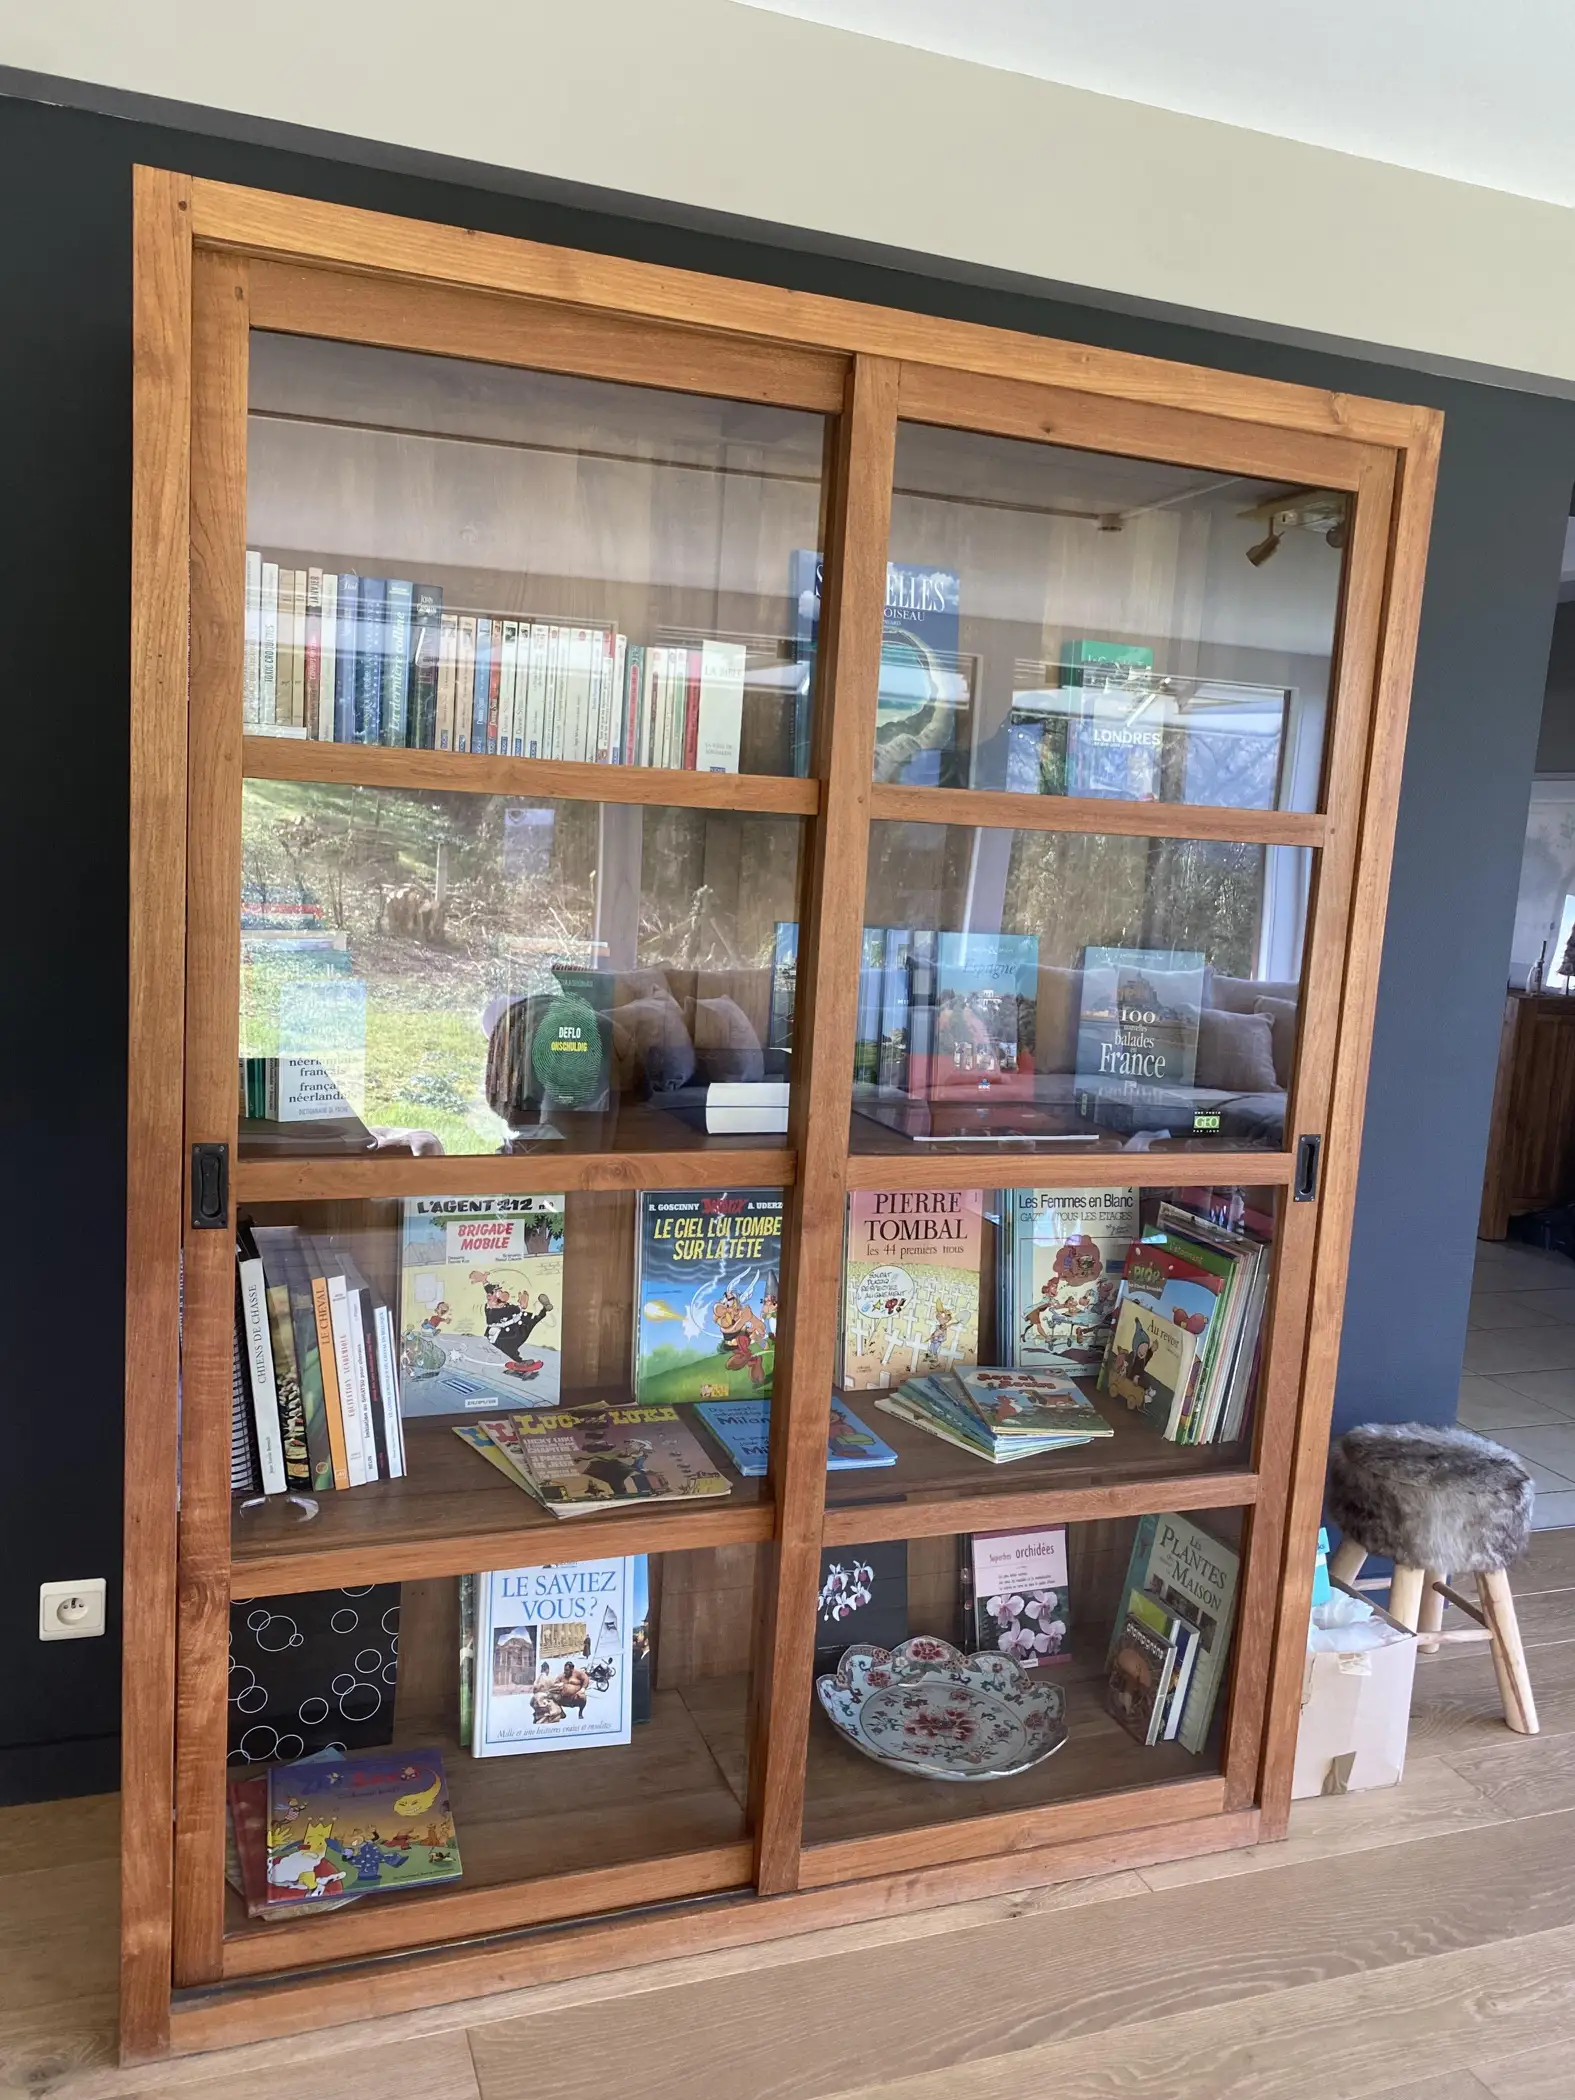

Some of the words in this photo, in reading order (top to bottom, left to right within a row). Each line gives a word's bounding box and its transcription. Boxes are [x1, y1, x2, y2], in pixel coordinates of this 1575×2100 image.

[309, 576, 320, 604] JANVIER
[392, 611, 406, 654] colline
[390, 656, 404, 709] dernière
[1094, 729, 1161, 746] LONDRES
[1120, 1009, 1156, 1024] 100
[559, 1027, 581, 1039] DEFLO
[1114, 1029, 1155, 1049] balades
[551, 1042, 588, 1052] ONSCHULDIG
[1098, 1042, 1166, 1079] France
[1194, 1116, 1219, 1128] GEO
[417, 1198, 497, 1214] L'AGENT
[497, 1198, 533, 1211] 212
[658, 1203, 699, 1211] GOSCINNY
[871, 1192, 962, 1215] PIERRE
[1019, 1194, 1038, 1209] Les
[1041, 1193, 1087, 1209] Femmes
[1089, 1196, 1102, 1208] en
[1104, 1193, 1134, 1208] Blanc
[1081, 1212, 1098, 1221] LES
[458, 1223, 514, 1237] BRIGADE
[653, 1218, 674, 1239] LE
[674, 1218, 705, 1239] CIEL
[707, 1217, 732, 1238] LUI
[734, 1216, 783, 1237] TOMBE
[864, 1219, 968, 1242] TOMBAL
[460, 1237, 511, 1251] MOBILE
[673, 1239, 705, 1260] SUR
[705, 1239, 727, 1260] LA
[728, 1236, 765, 1259] TÊTE
[866, 1244, 879, 1256] les
[883, 1244, 896, 1256] 44
[900, 1245, 938, 1259] premiers
[250, 1284, 261, 1326] CHASSE
[315, 1286, 329, 1330] CHEVAL
[254, 1327, 262, 1342] DE
[320, 1332, 331, 1345] LE
[257, 1344, 267, 1384] CHIENS
[609, 1406, 680, 1425] LUKE
[1015, 1542, 1055, 1559] orchidées
[1160, 1523, 1227, 1590] PLANTES
[502, 1576, 529, 1598] LE
[535, 1571, 617, 1596] SAVIEZ
[1171, 1560, 1222, 1611] MAISON
